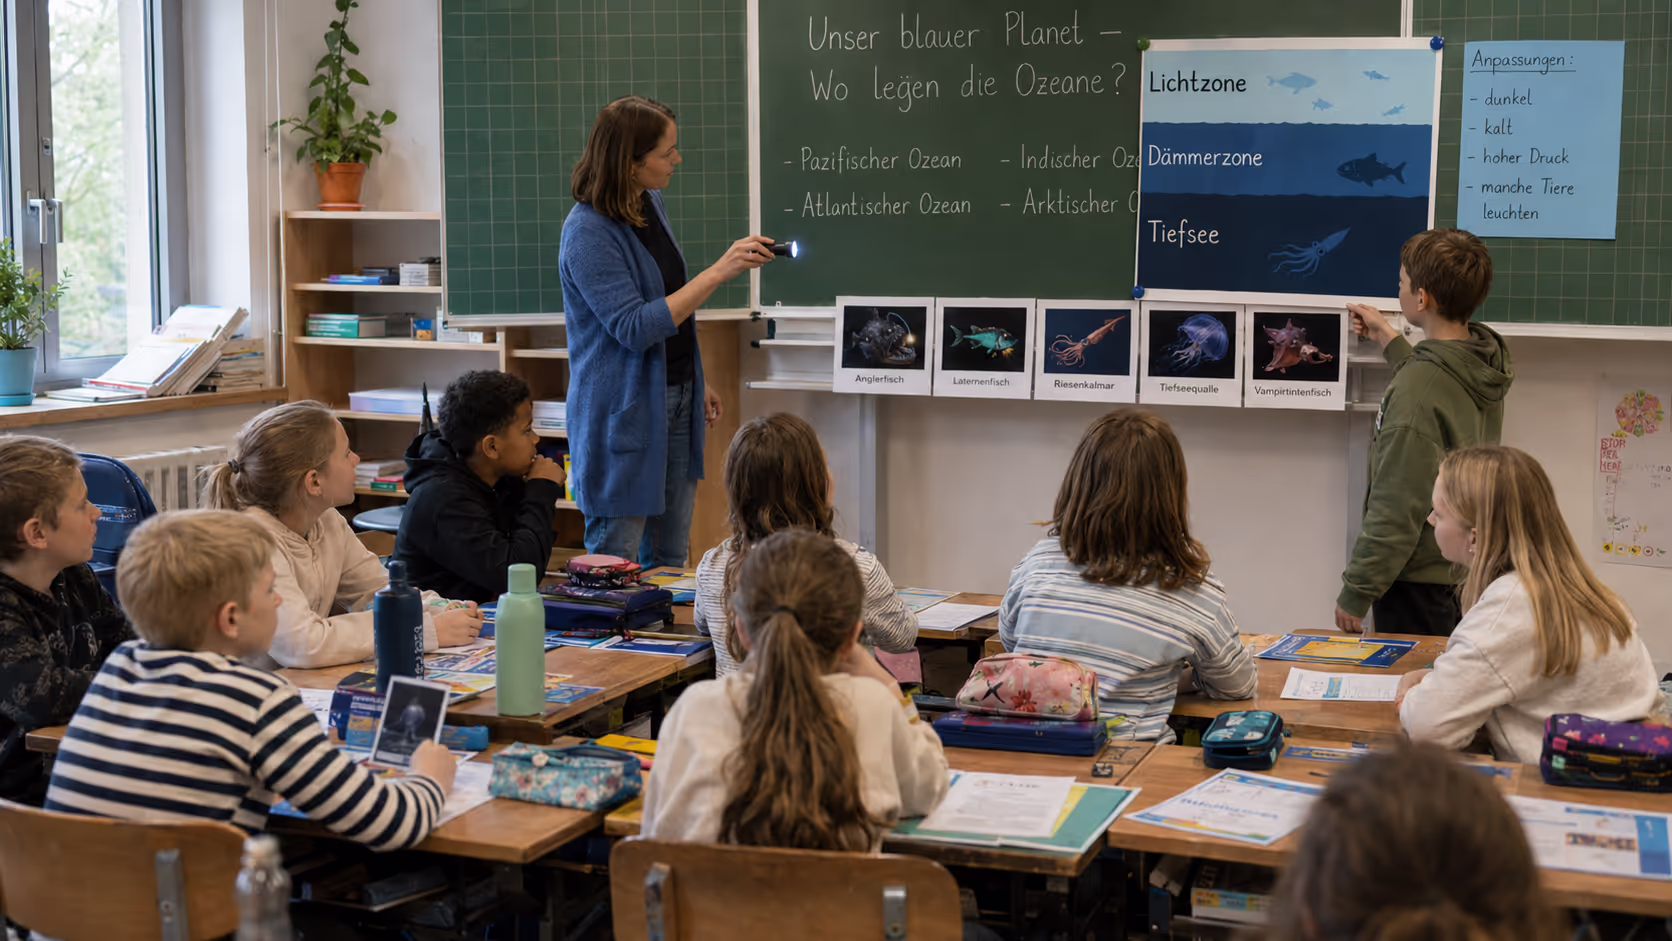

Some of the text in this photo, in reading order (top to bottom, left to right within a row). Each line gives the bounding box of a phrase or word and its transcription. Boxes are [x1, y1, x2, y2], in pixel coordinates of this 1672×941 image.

[808, 15, 880, 51] Unser
[900, 13, 980, 50] blauer
[1005, 9, 1084, 46] Planet
[810, 69, 849, 101] Wo
[960, 63, 998, 98] die
[1149, 70, 1247, 93] Lichtzone
[1484, 88, 1533, 106] dunkel
[1484, 118, 1513, 135] kalt
[801, 145, 899, 174] Pazifischer
[908, 147, 962, 170] Ozean
[1021, 143, 1101, 170] Indischer
[1148, 145, 1263, 167] Dämmerzone
[1483, 147, 1522, 164] hoher
[1530, 148, 1570, 164] Druck
[1481, 177, 1533, 195] manche
[1541, 178, 1575, 195] Tiere
[801, 191, 911, 218] Atlantischer
[919, 192, 971, 215] Ozean
[1022, 187, 1119, 215] Arktischer
[1483, 203, 1539, 220] leuchten
[1147, 219, 1220, 248] Tiefsee
[854, 374, 905, 385] Anglerfisch
[952, 377, 1010, 387] Laternenfisch
[1054, 379, 1116, 391] Riesenkalmar
[1160, 383, 1220, 395] Tiefseequalle
[1254, 386, 1332, 398] Vampirtintenfisch
